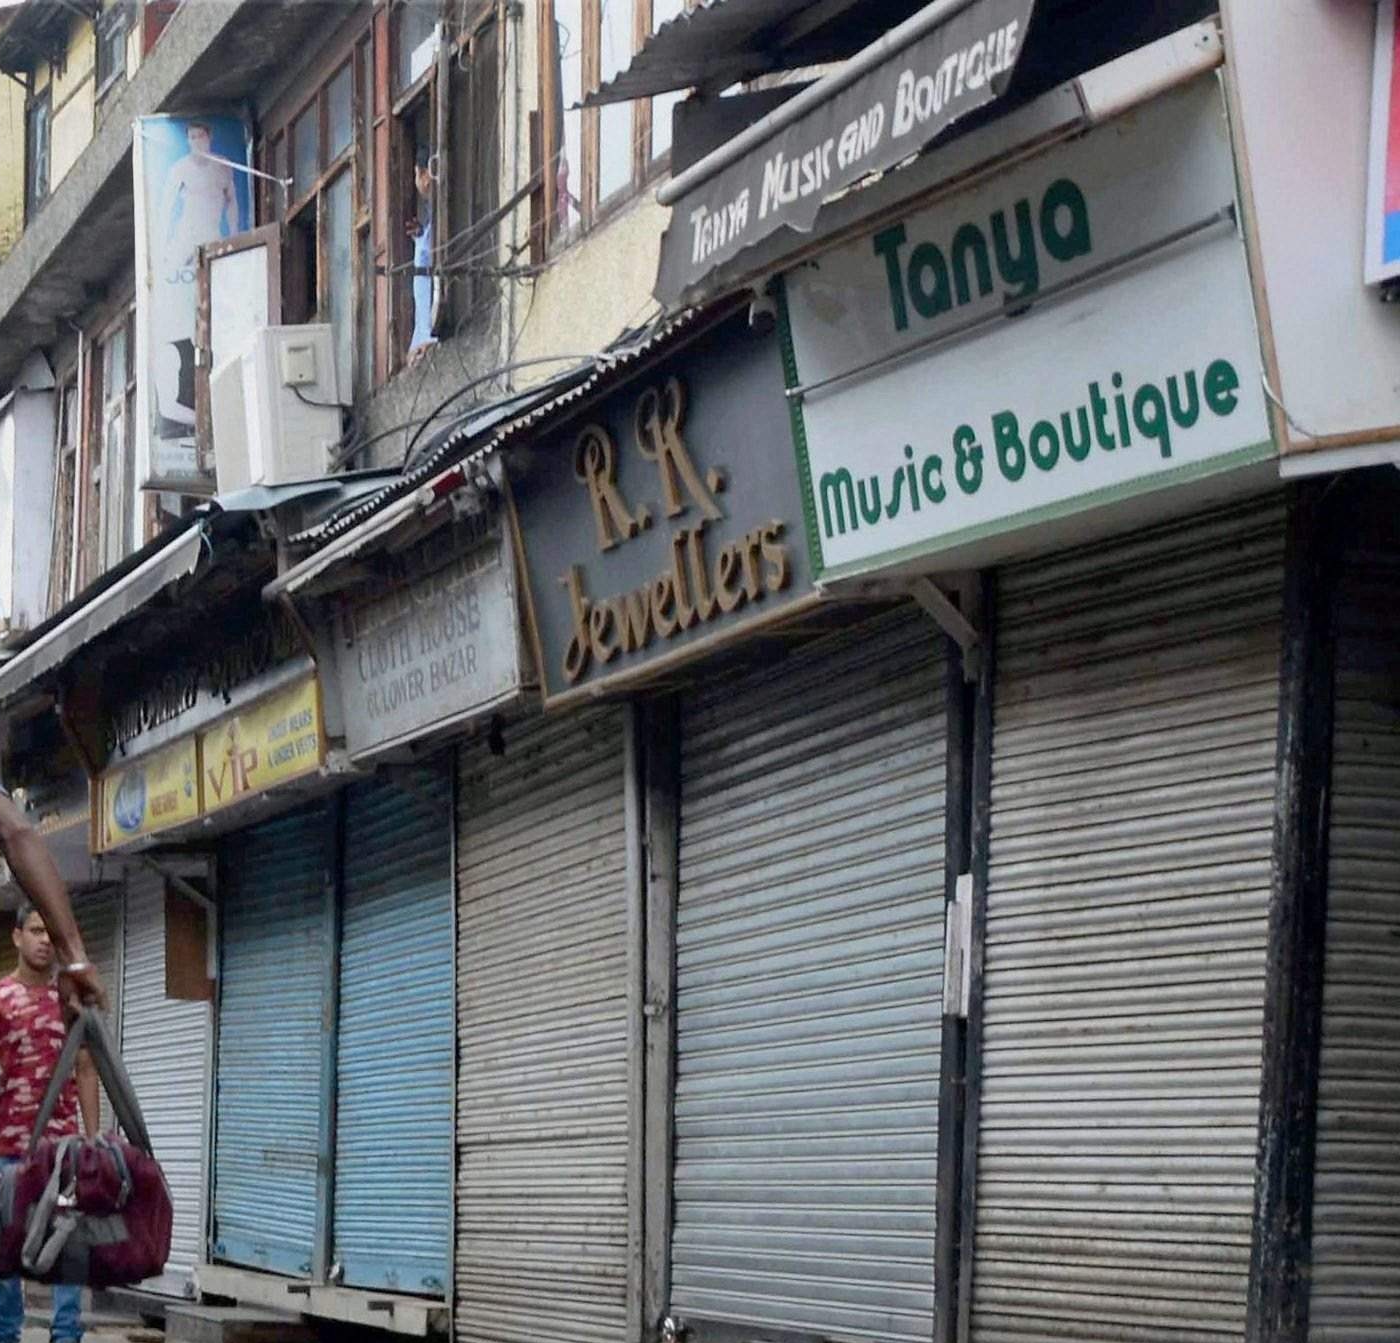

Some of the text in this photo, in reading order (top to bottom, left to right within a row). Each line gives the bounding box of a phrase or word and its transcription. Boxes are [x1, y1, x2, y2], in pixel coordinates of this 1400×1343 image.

[873, 178, 1092, 332] Tanya
[819, 358, 1240, 538] Music & Boutique
[357, 588, 481, 683] CLOTH HOUSE
[429, 644, 478, 693] BAZAR
[559, 517, 786, 682] Jewellers
